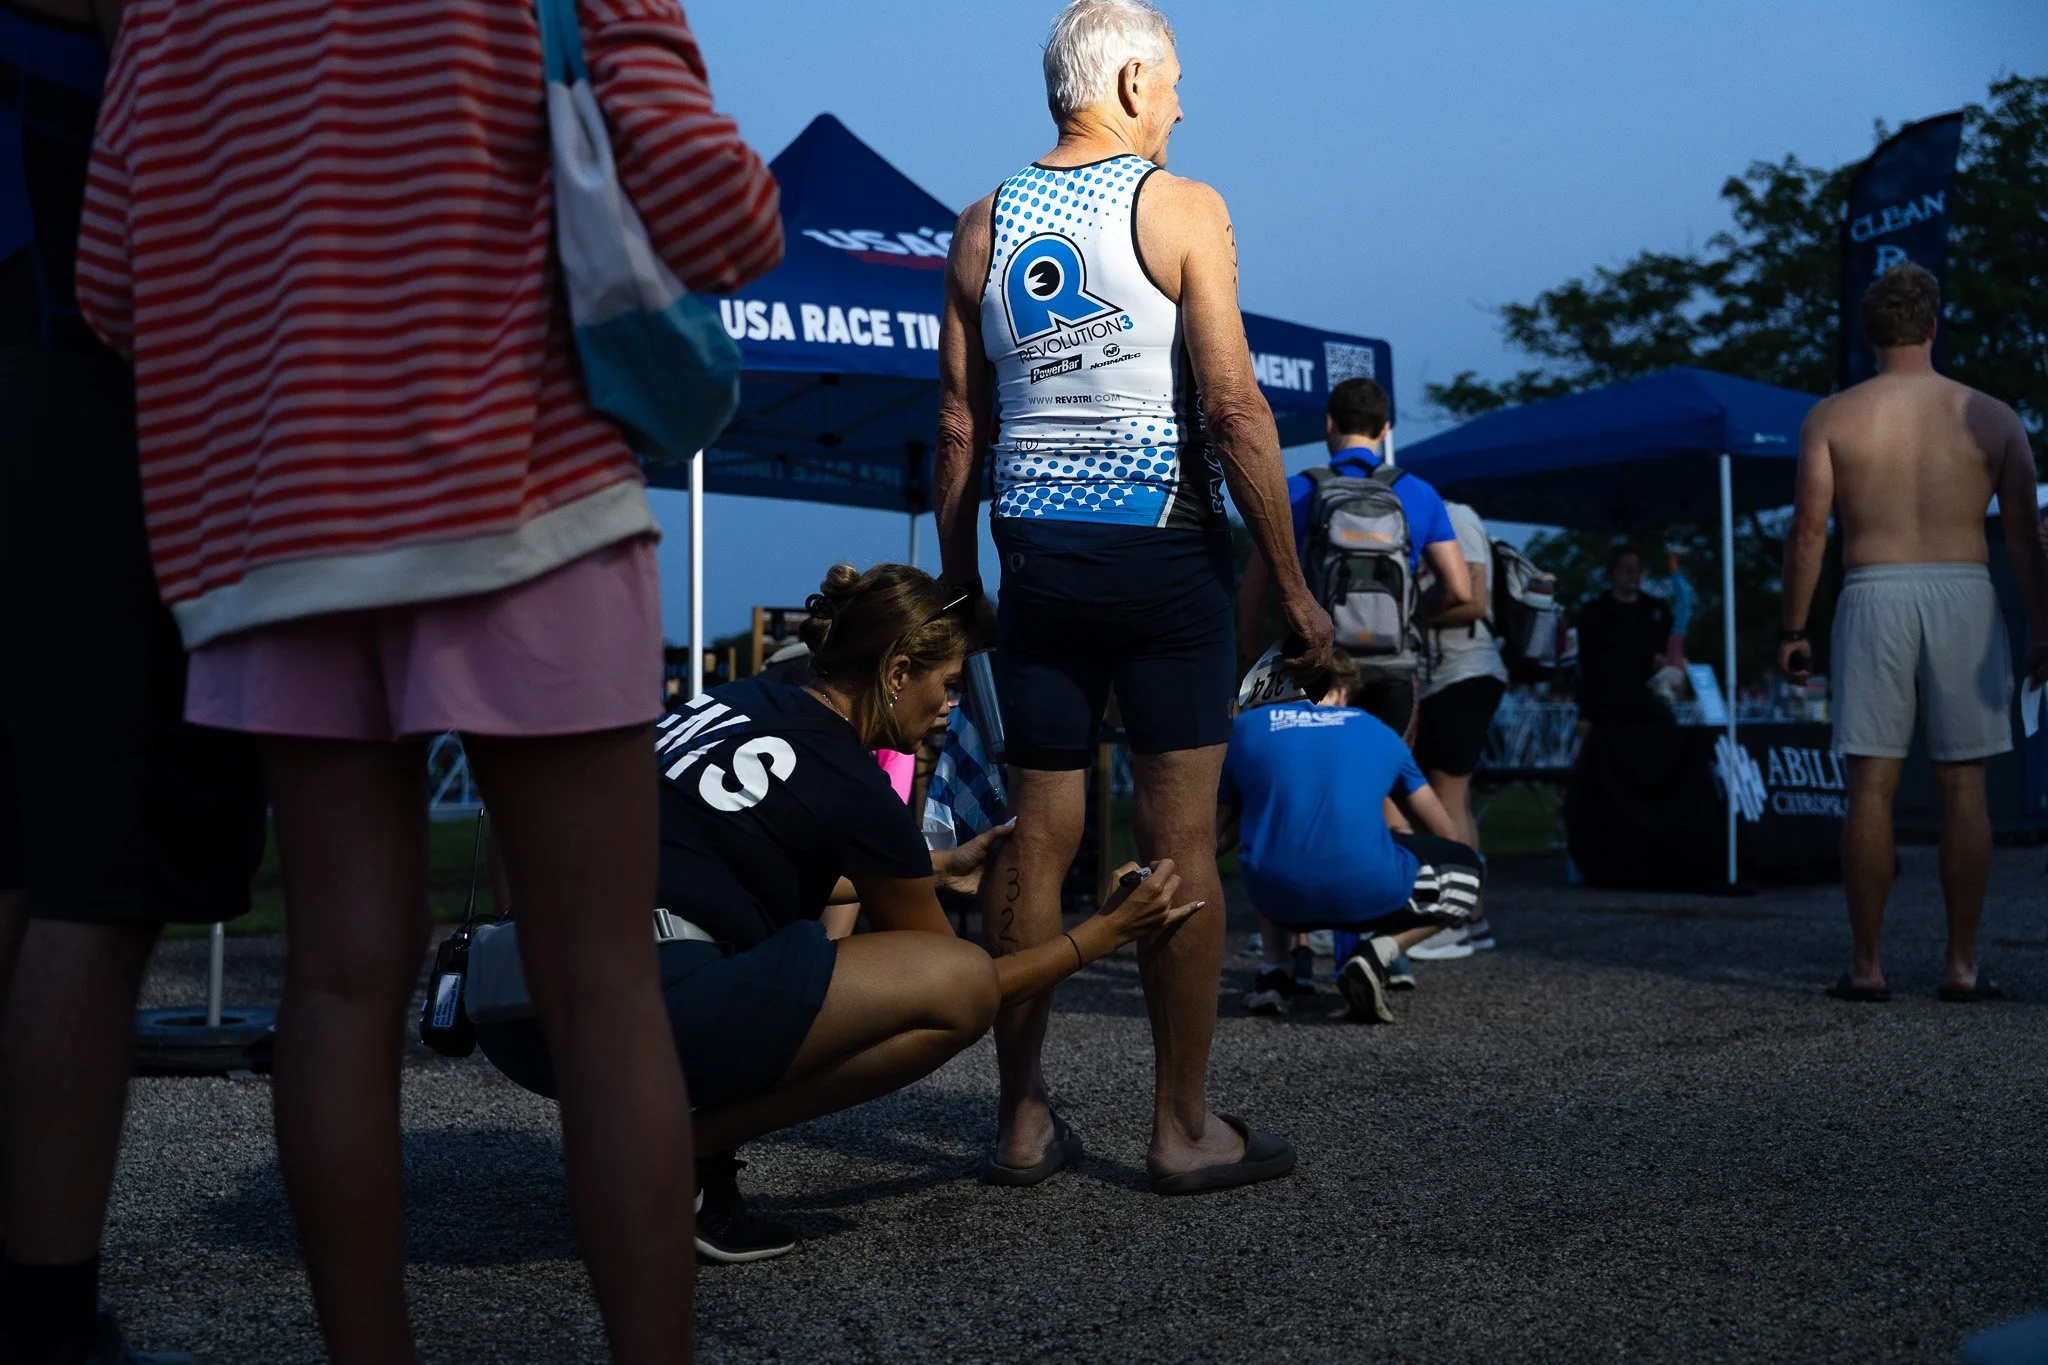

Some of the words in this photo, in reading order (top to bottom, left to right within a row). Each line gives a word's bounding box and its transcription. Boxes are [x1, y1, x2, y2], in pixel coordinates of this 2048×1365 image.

[1851, 190, 1945, 242] CLEAN
[720, 299, 796, 341] USA
[800, 303, 894, 347] RACE
[1032, 358, 1080, 381] PowerBar
